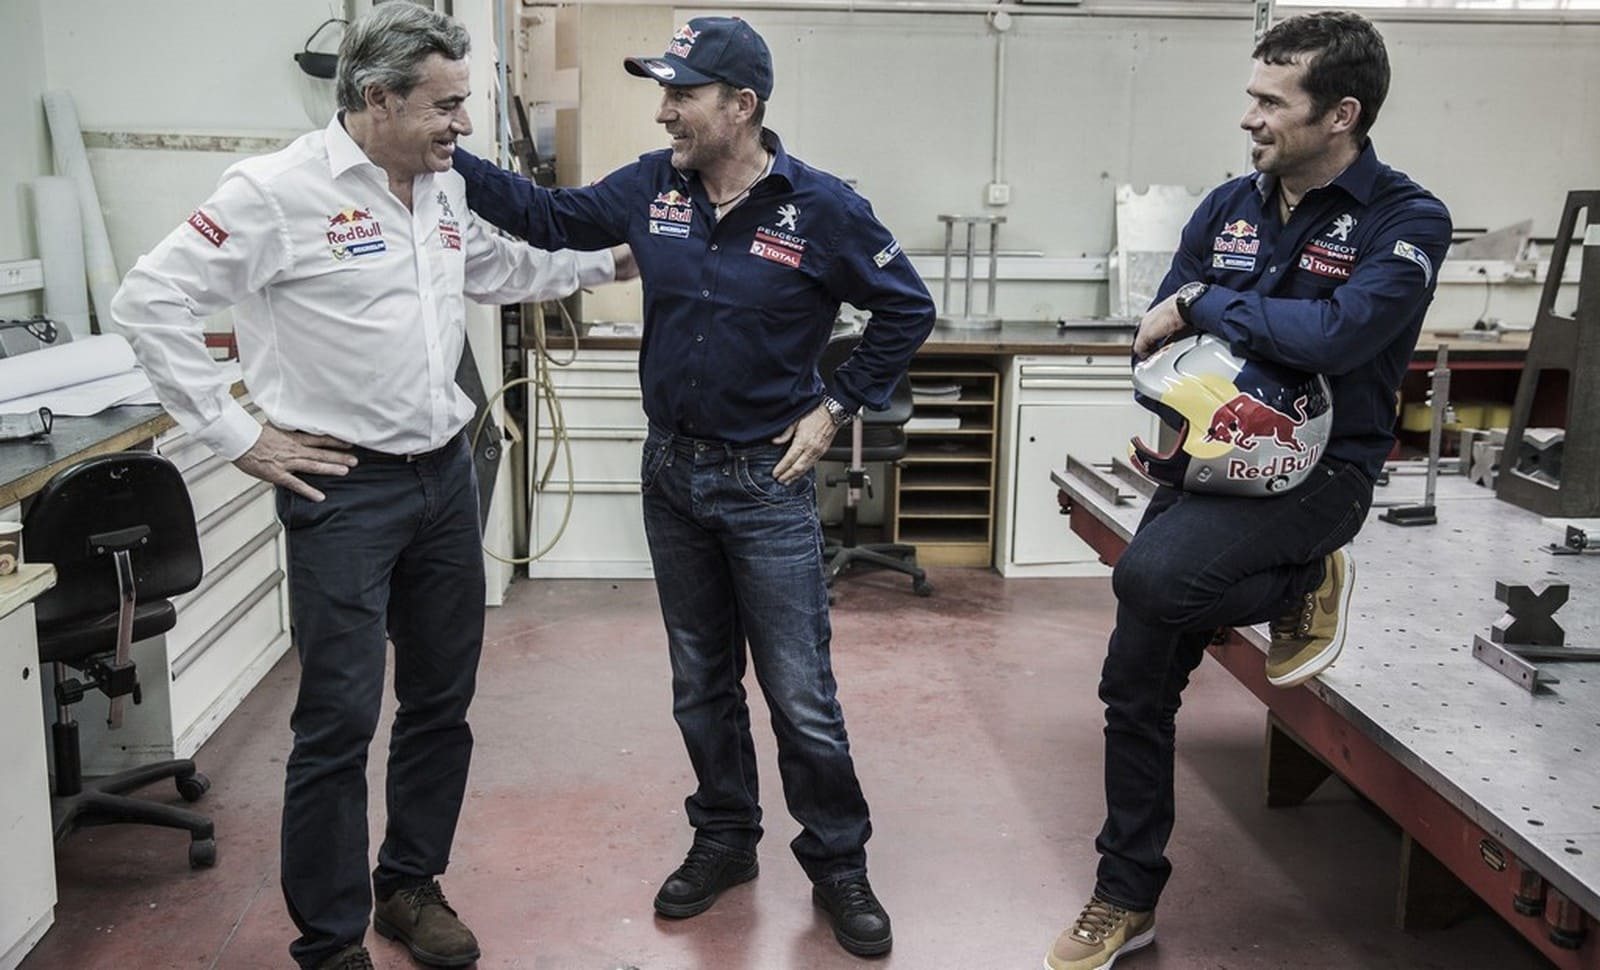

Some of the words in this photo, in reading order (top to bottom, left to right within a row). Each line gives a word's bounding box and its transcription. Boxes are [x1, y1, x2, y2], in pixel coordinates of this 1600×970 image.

[669, 207, 692, 223] Bull
[192, 214, 220, 243] TOTAL
[326, 226, 356, 245] Red
[355, 221, 382, 239] Bull
[756, 226, 808, 245] PEUGEOT
[1214, 236, 1237, 252] Red
[1236, 239, 1260, 255] Bull
[766, 247, 798, 265] TOTAL
[1327, 251, 1355, 261] SPORT
[1314, 260, 1350, 276] TOTAL
[1228, 456, 1278, 479] Red
[1281, 444, 1320, 474] Bull
